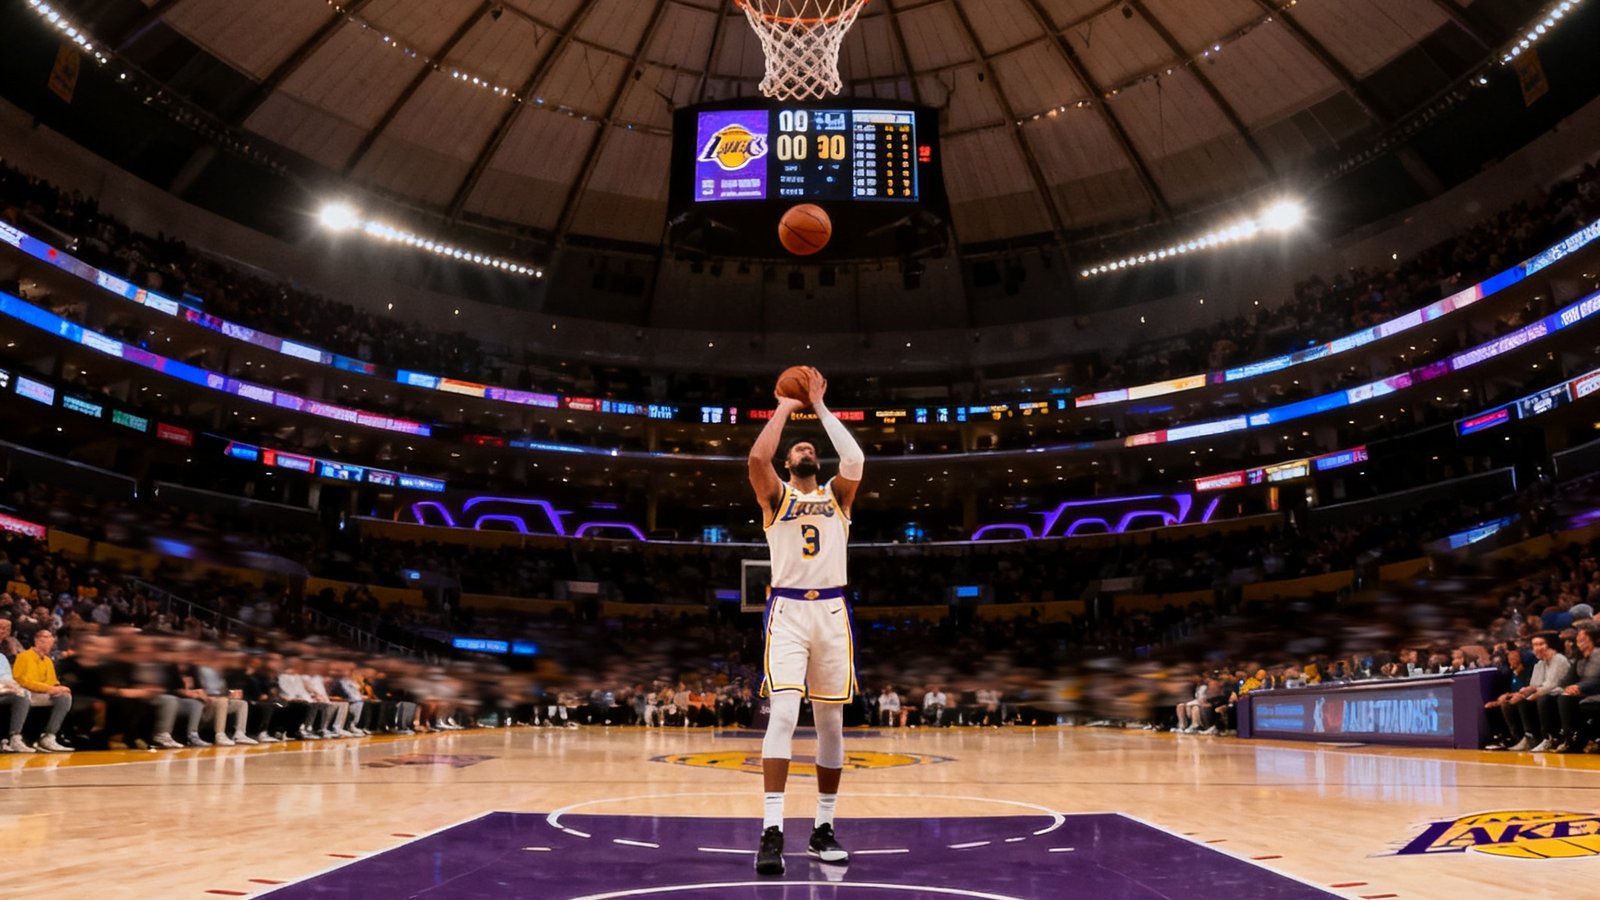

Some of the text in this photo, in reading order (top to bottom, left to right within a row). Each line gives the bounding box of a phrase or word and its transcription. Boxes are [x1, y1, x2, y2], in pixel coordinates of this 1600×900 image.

[777, 134, 807, 160] 00
[817, 134, 845, 160] 30
[801, 524, 820, 559] 3
[1396, 818, 1600, 855] LAKE
